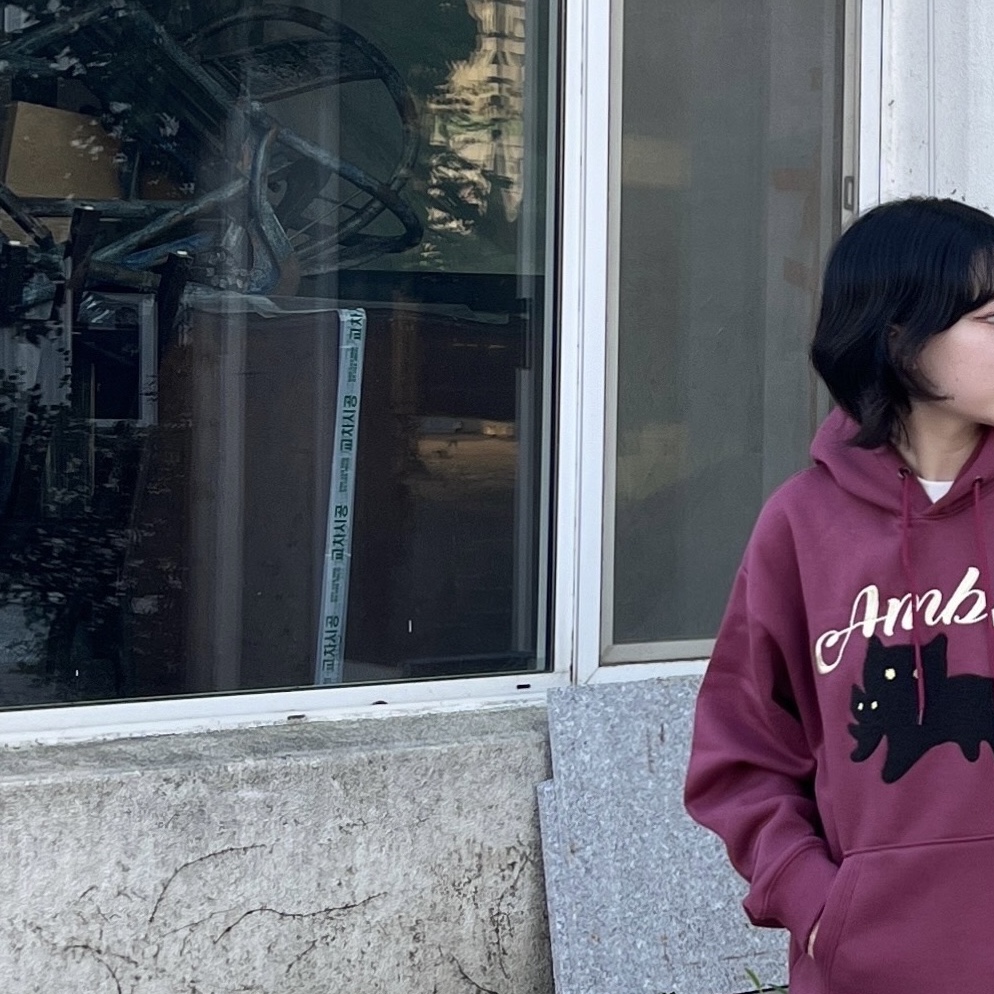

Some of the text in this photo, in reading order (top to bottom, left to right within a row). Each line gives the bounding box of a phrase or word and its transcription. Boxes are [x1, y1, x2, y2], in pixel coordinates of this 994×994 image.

[349, 312, 362, 341] 교차
[340, 395, 358, 452] 교차시공
[331, 504, 349, 562] 교차시공
[322, 615, 339, 672] 교차시공
